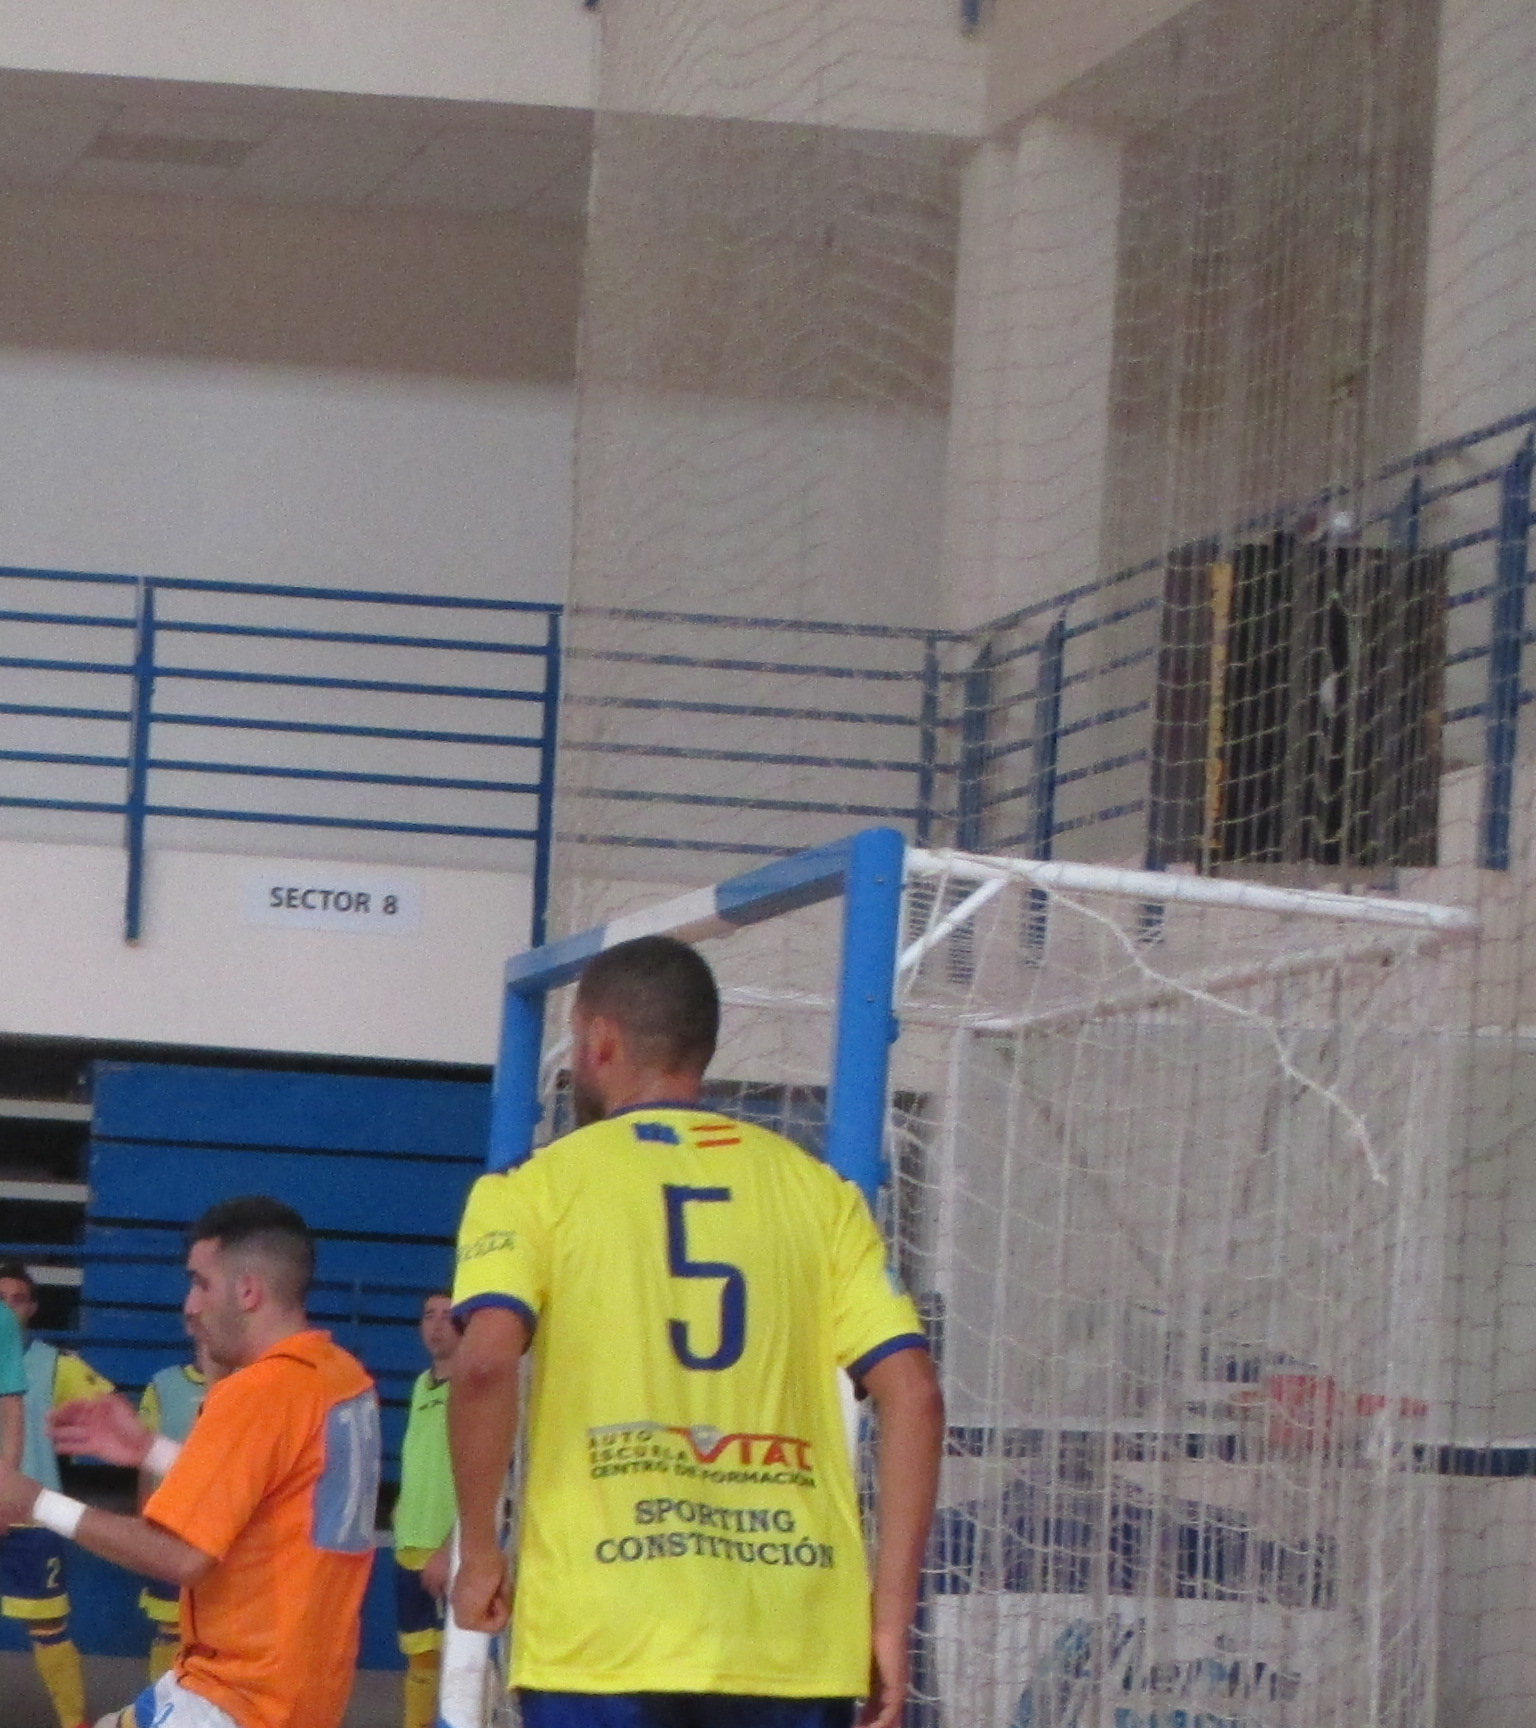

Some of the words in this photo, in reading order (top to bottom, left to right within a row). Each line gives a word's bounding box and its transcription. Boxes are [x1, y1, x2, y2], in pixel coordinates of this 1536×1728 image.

[269, 886, 371, 914] SECTOR
[382, 894, 398, 915] 8
[663, 1185, 746, 1371] 5
[634, 1498, 795, 1534] SPORTING
[595, 1532, 835, 1567] CONSTITUCIÓN
[45, 1557, 62, 1589] 2
